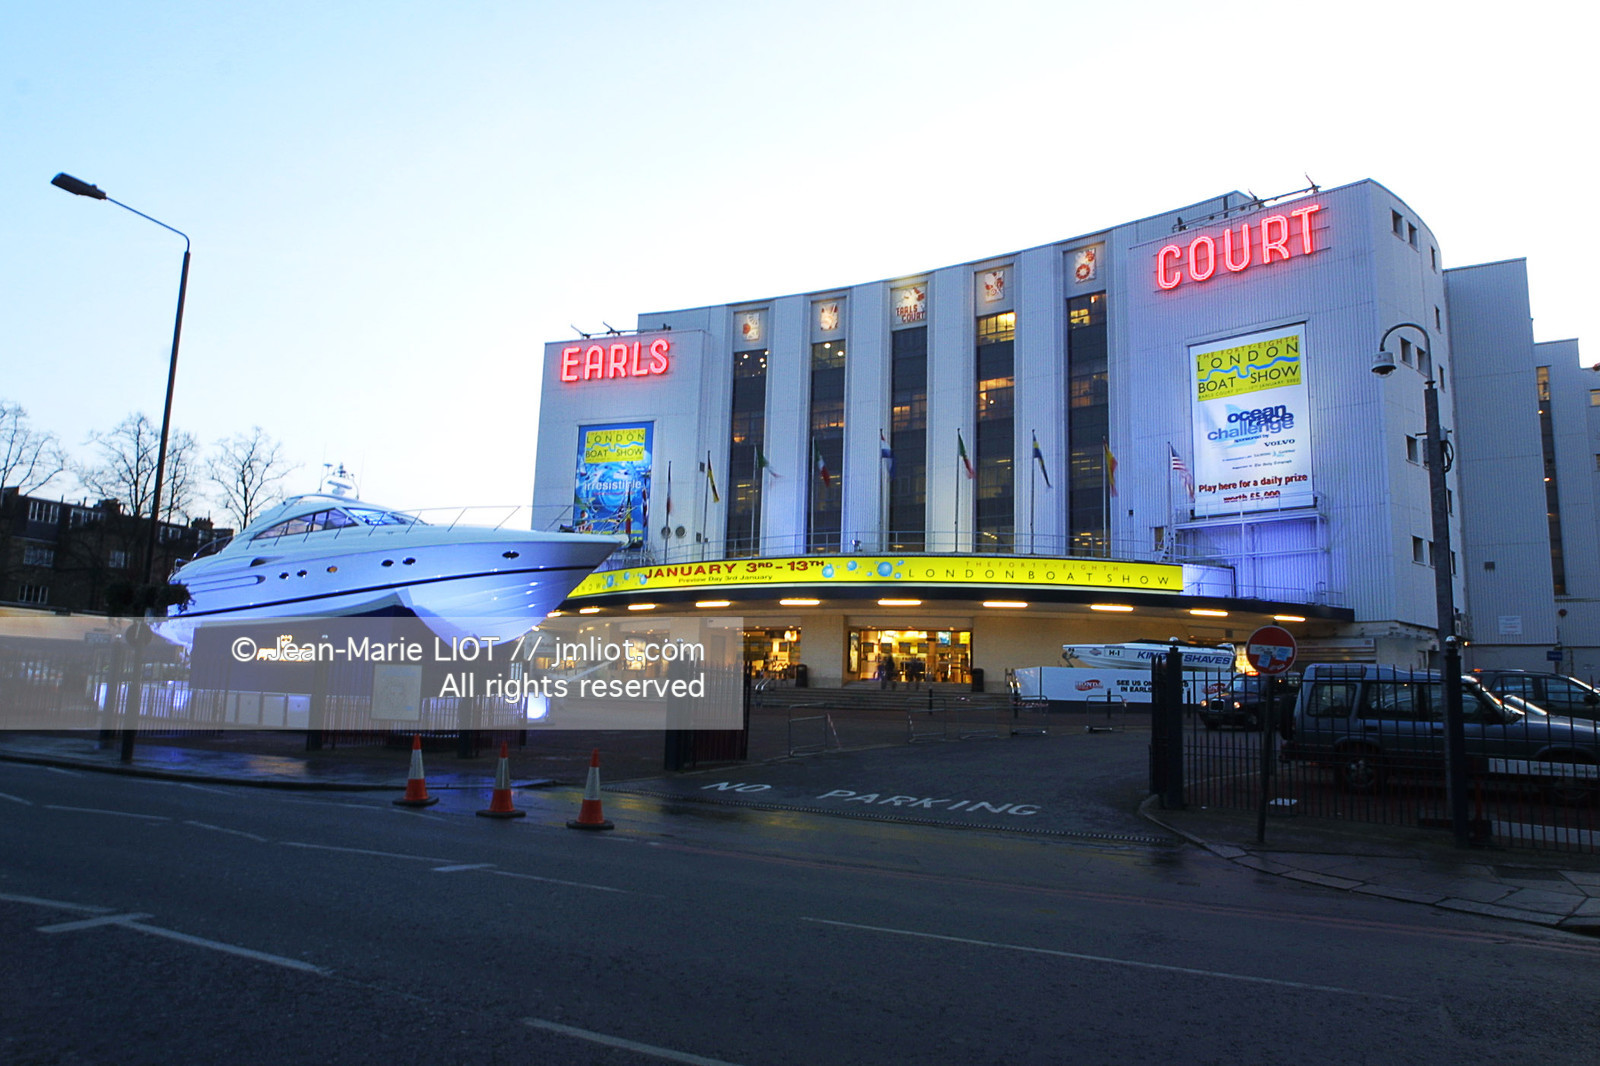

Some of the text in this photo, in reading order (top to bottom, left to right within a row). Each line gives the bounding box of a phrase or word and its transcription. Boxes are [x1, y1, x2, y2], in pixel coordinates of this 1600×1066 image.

[1157, 204, 1322, 290] COURT
[1221, 336, 1298, 355] FORTY-EIGHTH
[561, 338, 670, 382] EARLS
[1197, 342, 1298, 372] LONDON
[1198, 376, 1236, 394] BOAT
[1250, 365, 1298, 384] SHOW
[1227, 404, 1287, 424] ocean
[586, 433, 645, 444] LONDON
[1207, 418, 1294, 441] challenge
[1264, 438, 1296, 447] VOLVO
[585, 448, 644, 458] BOAT SHOW
[1199, 484, 1217, 494] Play
[1218, 481, 1238, 491] here
[1239, 480, 1251, 488] for
[1260, 476, 1283, 486] daily
[1284, 473, 1308, 486] prize
[644, 563, 738, 579] JANUARY
[746, 562, 774, 573] 3RD
[787, 560, 825, 572] 13TH
[965, 560, 1120, 572] THE FORTY-EIGHTH
[908, 569, 1170, 586] LONDON BOAT SHOW
[1184, 654, 1232, 665] SHAVES
[701, 781, 1043, 816] NO PARKING
